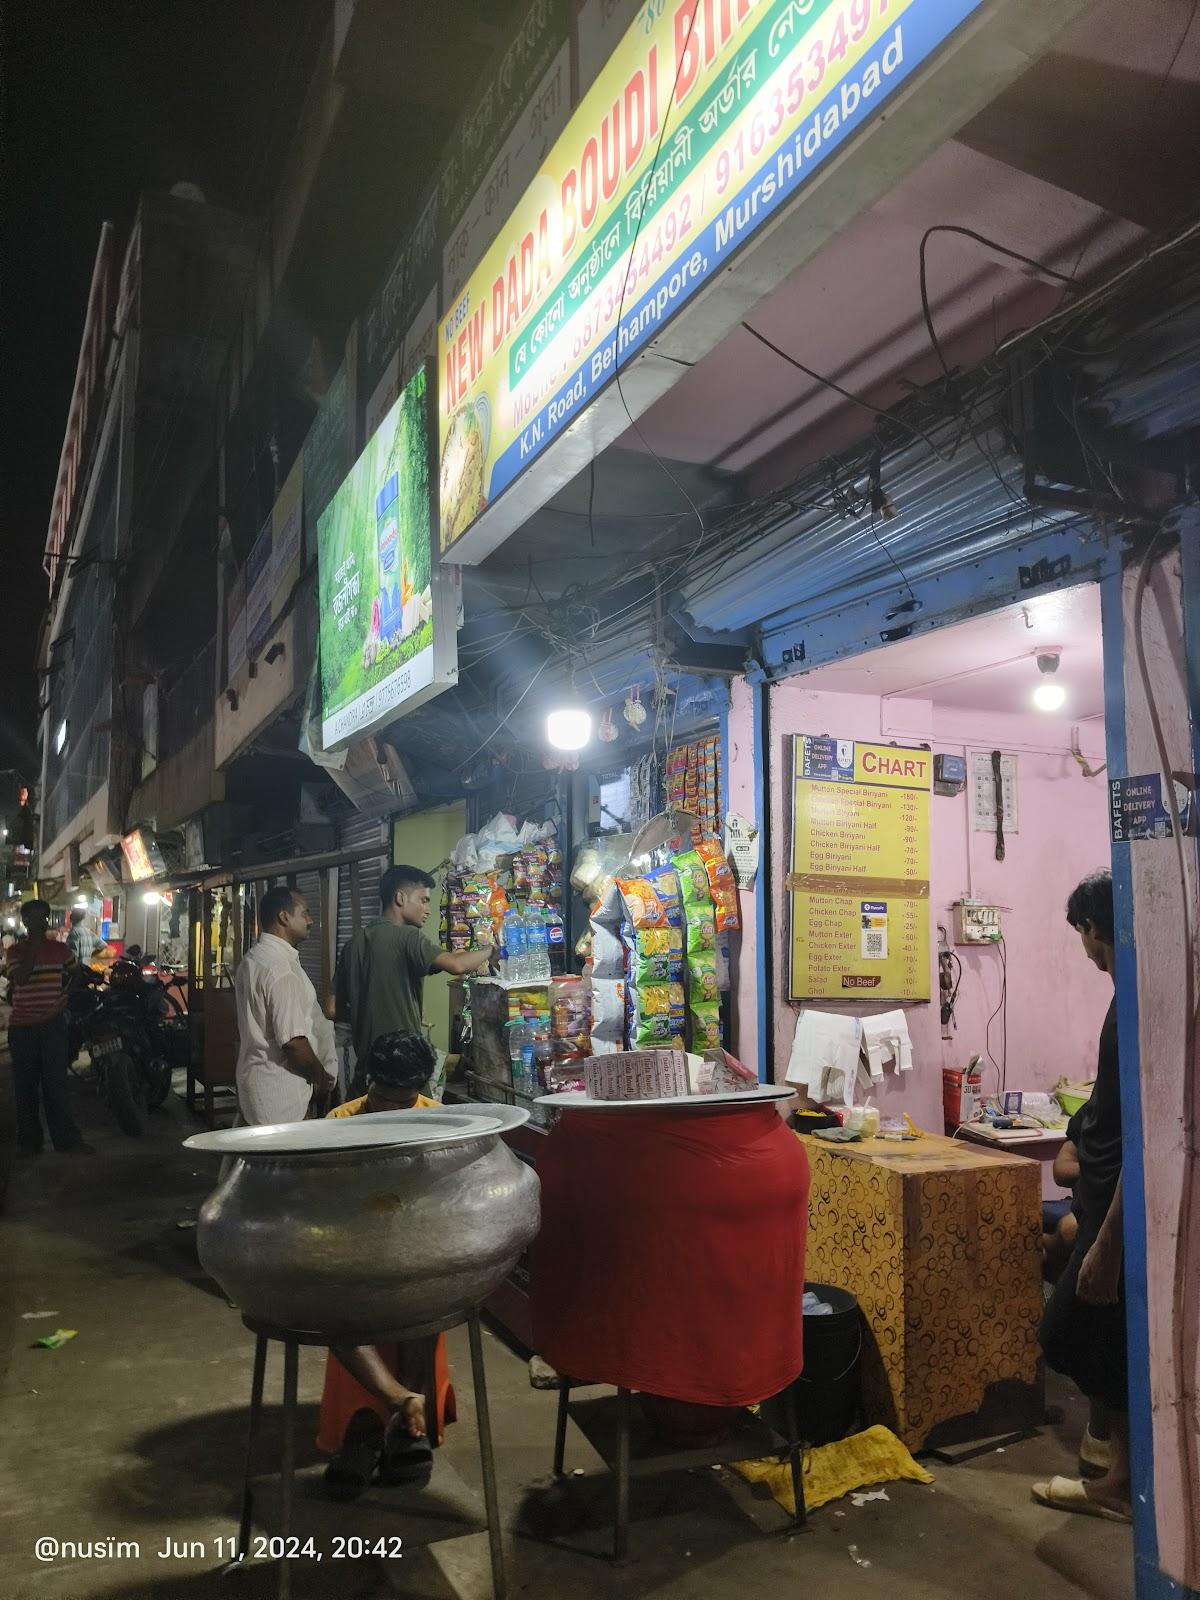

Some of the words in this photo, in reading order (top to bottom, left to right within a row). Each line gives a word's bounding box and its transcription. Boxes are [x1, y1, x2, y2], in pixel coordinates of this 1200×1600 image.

[531, 293, 565, 354] কোনো
[567, 222, 621, 299] অনুষ্ঠানে
[624, 126, 693, 235] বিরিয়ানী
[698, 48, 758, 134] অর্ডার
[445, 302, 486, 416] NEW
[492, 209, 552, 352] DADA
[561, 44, 659, 257] BOUDI
[519, 425, 545, 459] K.N.
[548, 371, 587, 429] Road,
[591, 250, 708, 383] Berhampore,
[715, 25, 904, 252] Murshidabad
[862, 751, 927, 778] CHART
[811, 783, 835, 793] Mutton
[836, 785, 861, 796] Special
[1126, 786, 1152, 797] ONLINE
[1112, 781, 1123, 839] BAFETS
[1123, 800, 1156, 812] DELIVERY
[1133, 816, 1147, 825] APP
[863, 822, 877, 830] Half
[810, 829, 839, 838] Chicken
[810, 840, 839, 849] Chicken
[866, 844, 881, 852] Half
[810, 851, 824, 860] Egg
[810, 862, 824, 872] Egg
[852, 865, 867, 873] Half
[808, 896, 833, 904] Mutton
[834, 897, 853, 906] Chap
[808, 907, 837, 916] Chicken
[838, 908, 857, 917] Chap
[808, 918, 823, 928] Egg
[824, 919, 843, 928] Chap
[808, 930, 833, 938] Mutton
[808, 942, 837, 950] Chicken
[808, 952, 823, 962] Egg
[844, 977, 854, 986] No
[856, 977, 876, 986] Beef
